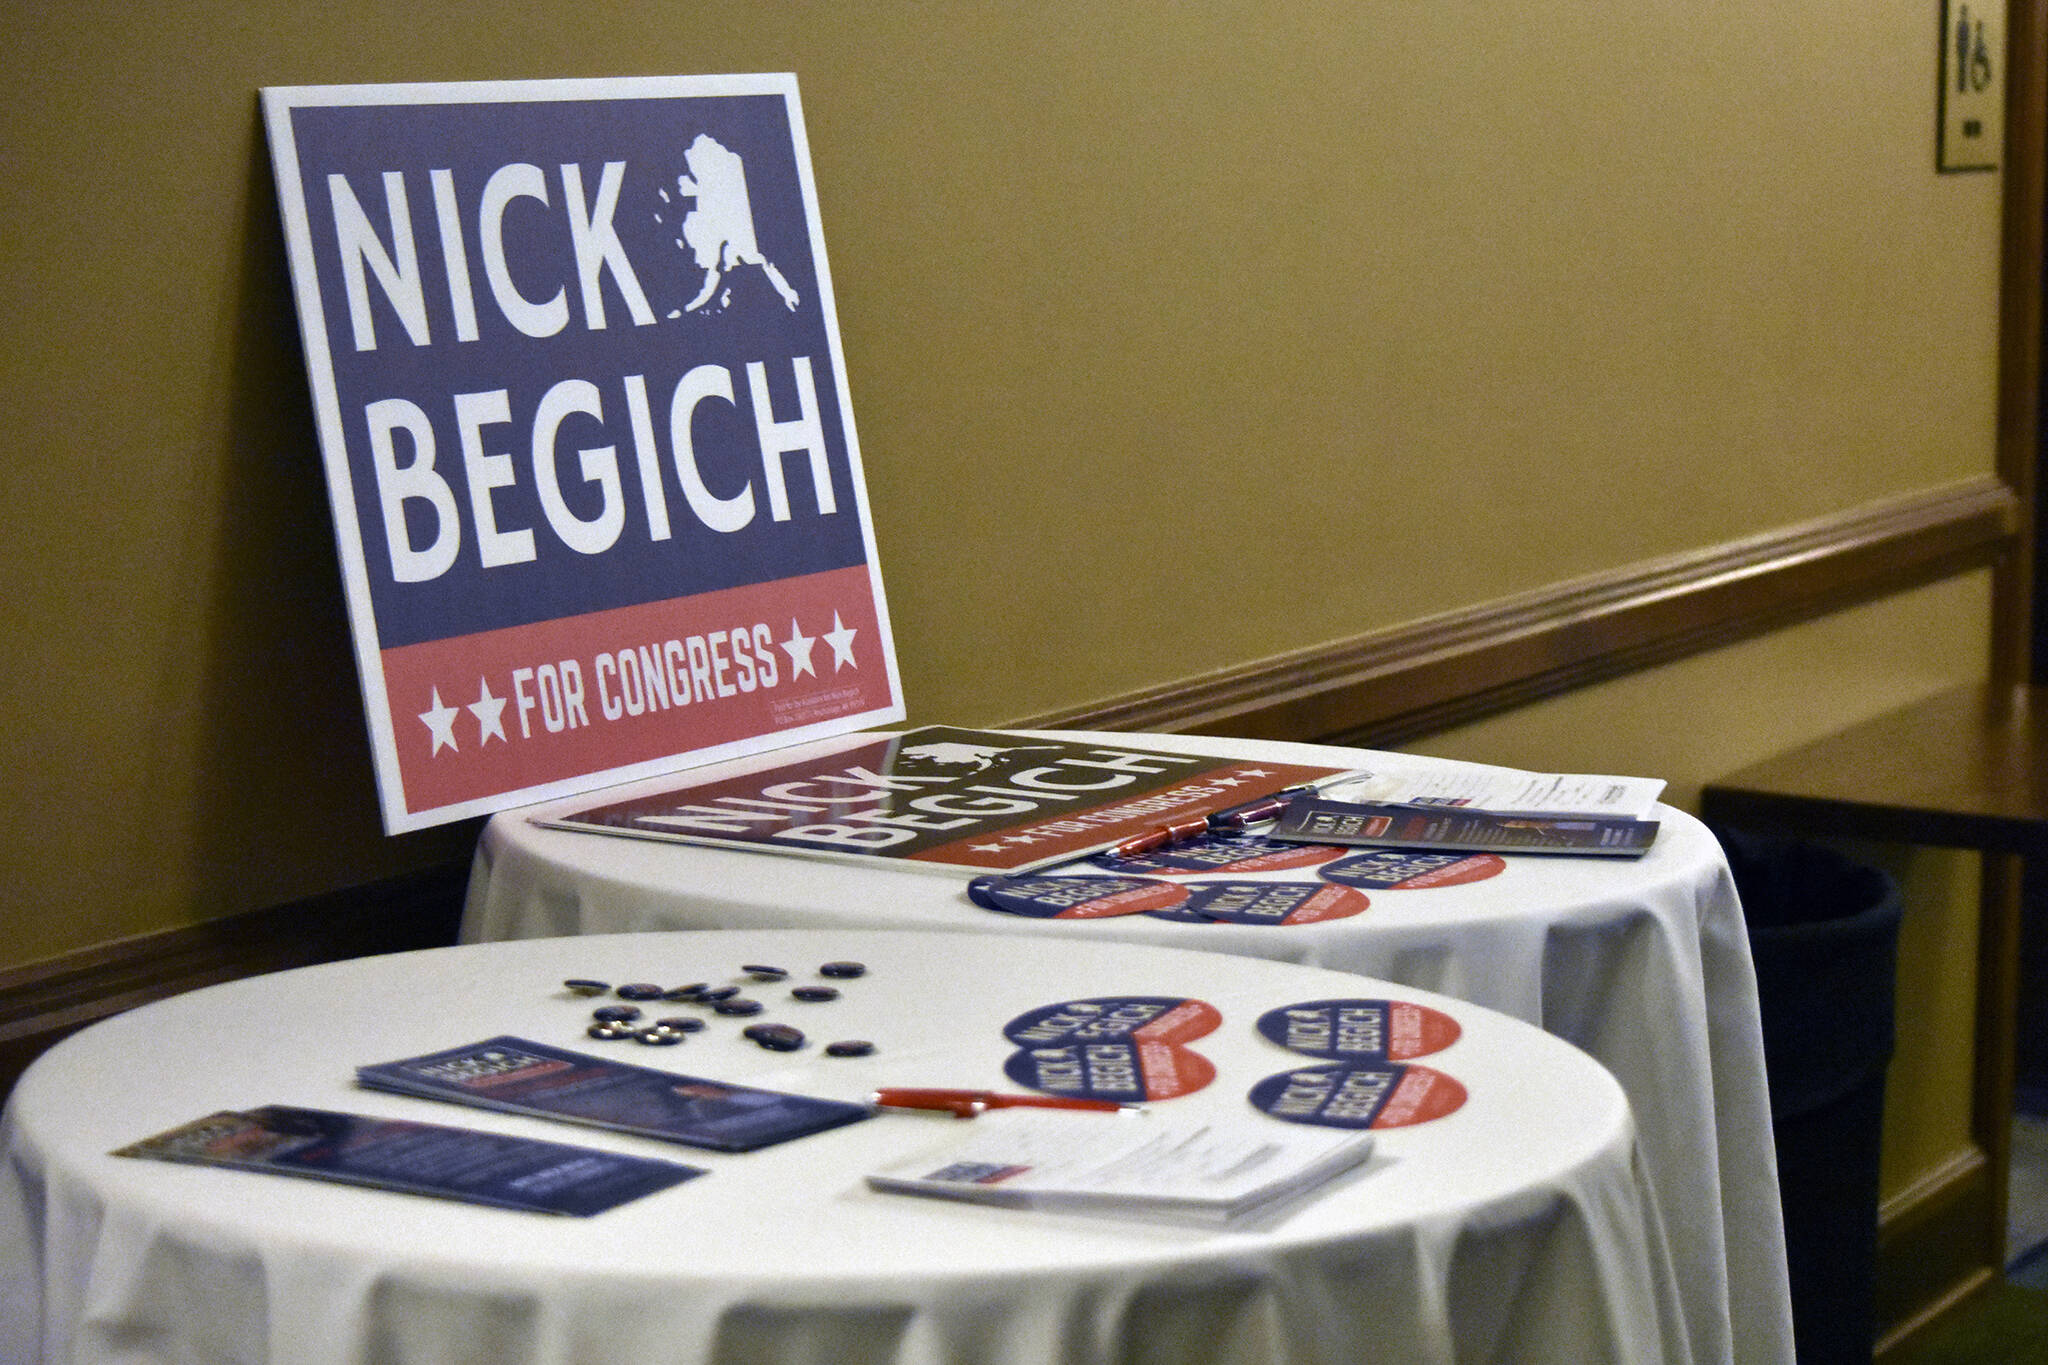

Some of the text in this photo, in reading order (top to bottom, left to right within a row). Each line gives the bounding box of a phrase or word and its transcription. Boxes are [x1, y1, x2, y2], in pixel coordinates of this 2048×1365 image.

[327, 160, 658, 352] NICK
[364, 356, 837, 583] BEGICH
[512, 659, 590, 739] FOR
[594, 622, 779, 721] CONGRESS
[634, 766, 961, 832] NICK
[771, 750, 1200, 849] BEGICH
[1022, 785, 1226, 837] FOR CONGRESS
[1034, 880, 1143, 906] BEGICH
[1326, 860, 1400, 878] NICK
[1363, 854, 1461, 882] BEGICH
[1244, 886, 1314, 916] BEGICH
[1014, 1012, 1098, 1040] NICK
